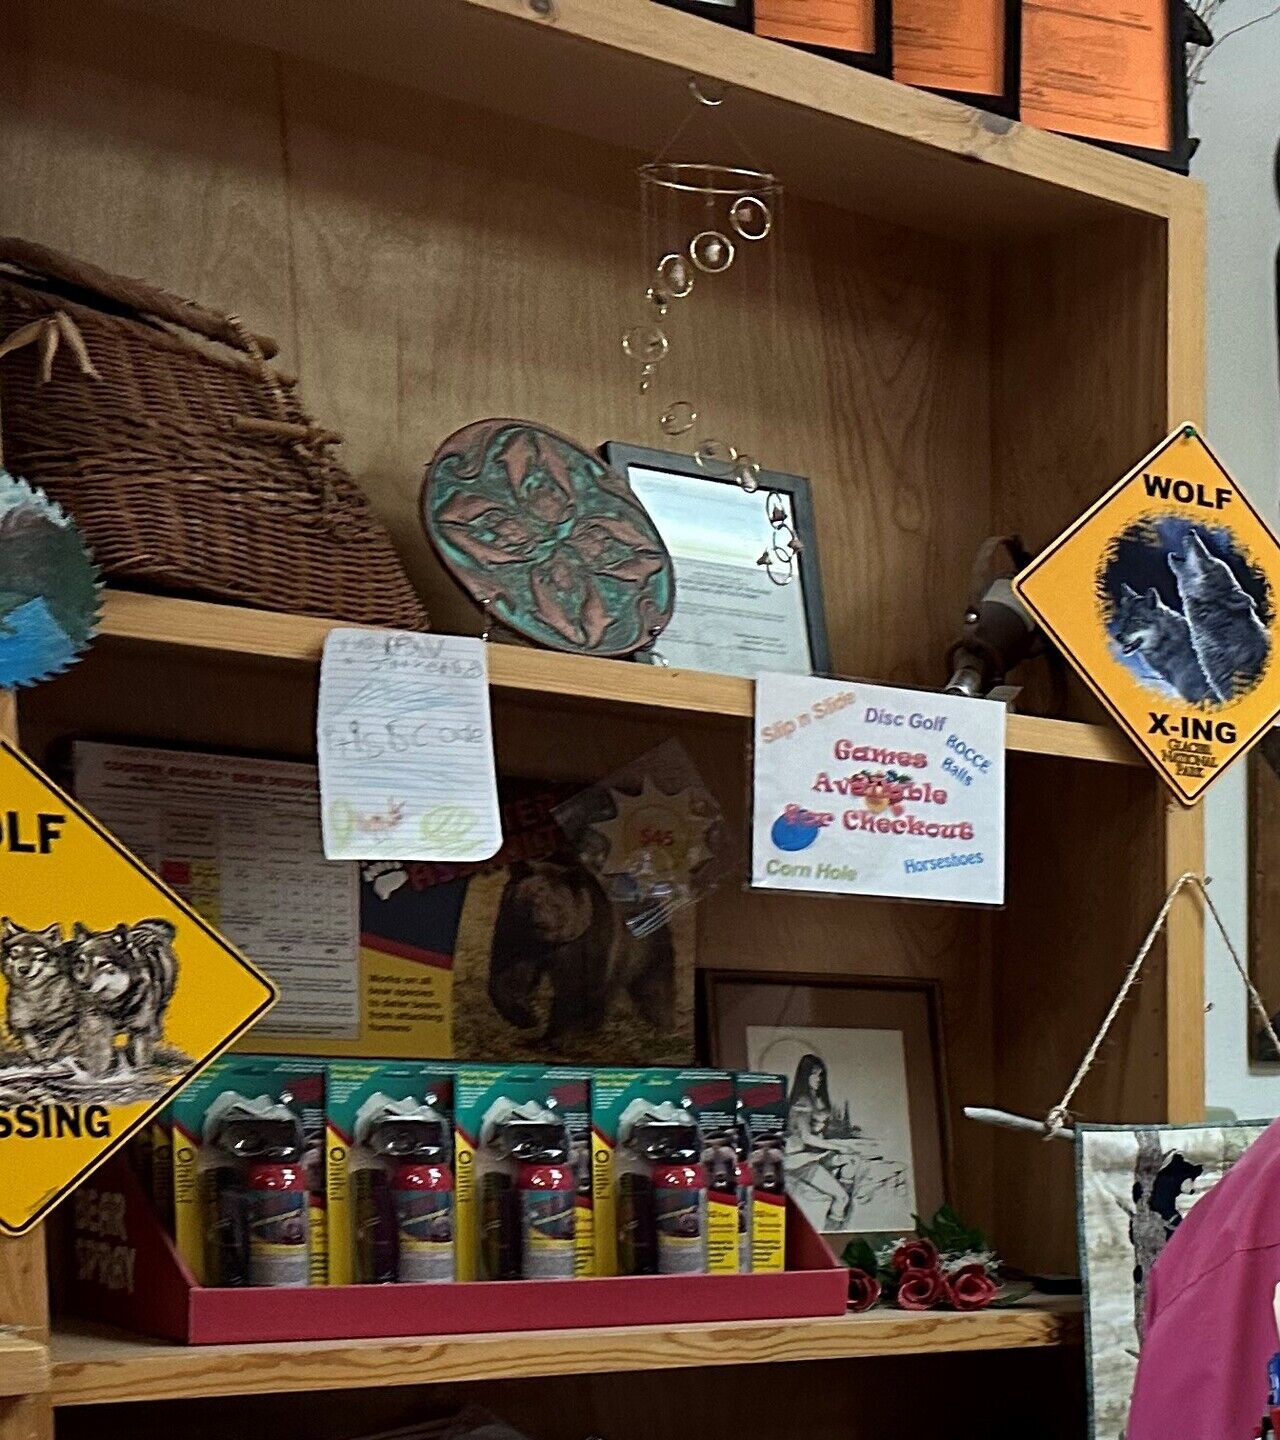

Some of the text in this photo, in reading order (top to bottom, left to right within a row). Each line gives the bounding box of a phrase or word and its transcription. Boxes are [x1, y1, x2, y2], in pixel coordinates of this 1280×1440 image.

[1143, 474, 1232, 510] WOLF
[864, 707, 949, 732] Disc Golf
[1149, 711, 1237, 744] X-ING
[833, 738, 929, 769] Games
[946, 733, 994, 775] BOCCE
[941, 756, 975, 787] Balls
[0, 811, 66, 854] LF
[842, 809, 975, 841] Checkout
[766, 858, 858, 882] Corn Hole
[904, 850, 984, 875] Horseshoes
